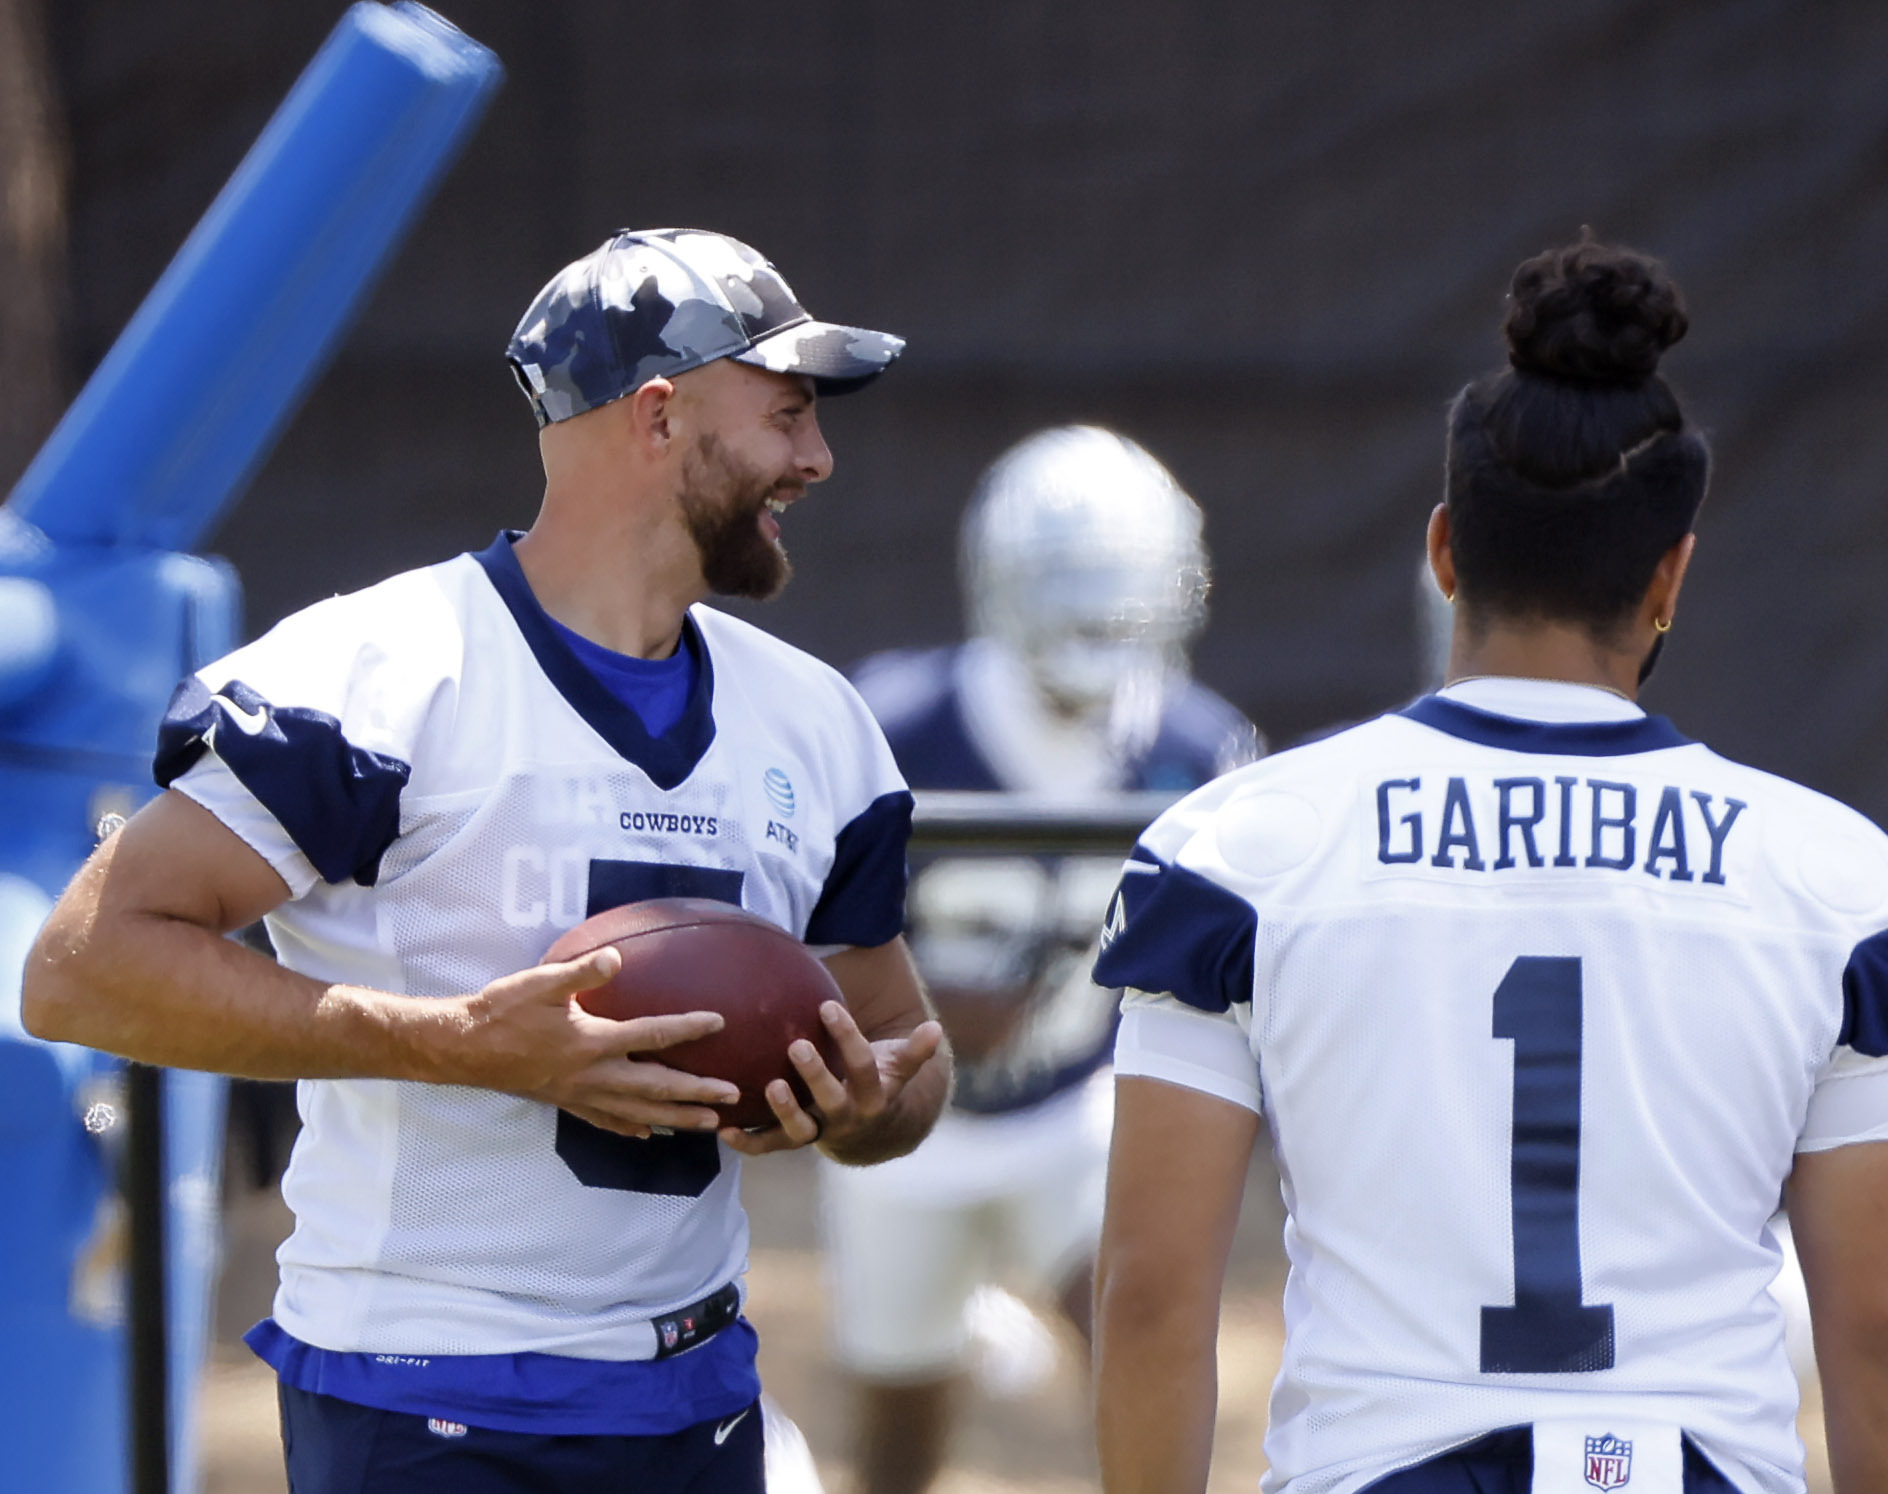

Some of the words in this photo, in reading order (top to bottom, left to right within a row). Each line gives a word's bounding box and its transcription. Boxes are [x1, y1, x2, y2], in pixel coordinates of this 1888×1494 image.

[619, 811, 719, 836] COWBOYS
[766, 819, 799, 855] AT&T
[1375, 775, 1749, 886] GARIBAY
[1480, 956, 1615, 1374] 1
